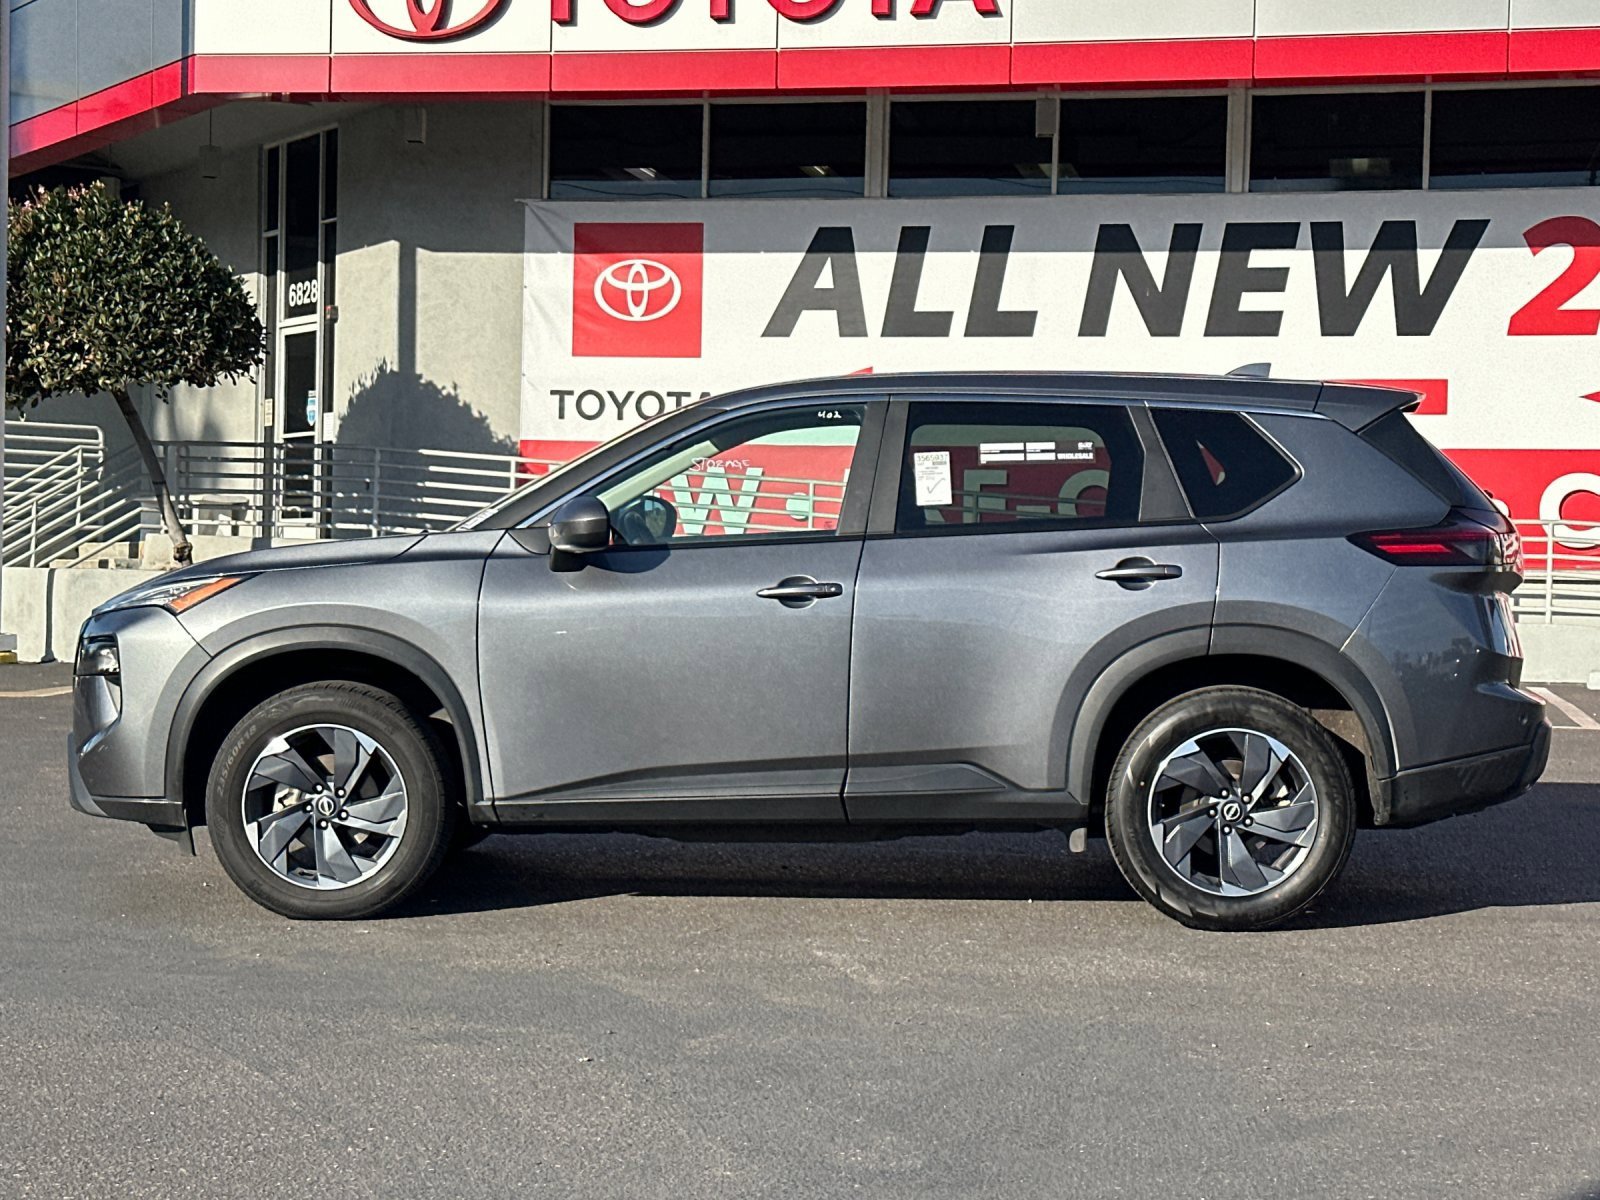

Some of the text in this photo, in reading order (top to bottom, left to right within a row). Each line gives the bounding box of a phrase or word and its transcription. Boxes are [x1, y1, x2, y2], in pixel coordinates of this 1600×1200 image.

[288, 279, 318, 307] 6828
[760, 224, 1038, 338] ALL
[1078, 218, 1492, 337] NEW
[549, 389, 712, 421] TOYOT
[817, 410, 843, 419] 402
